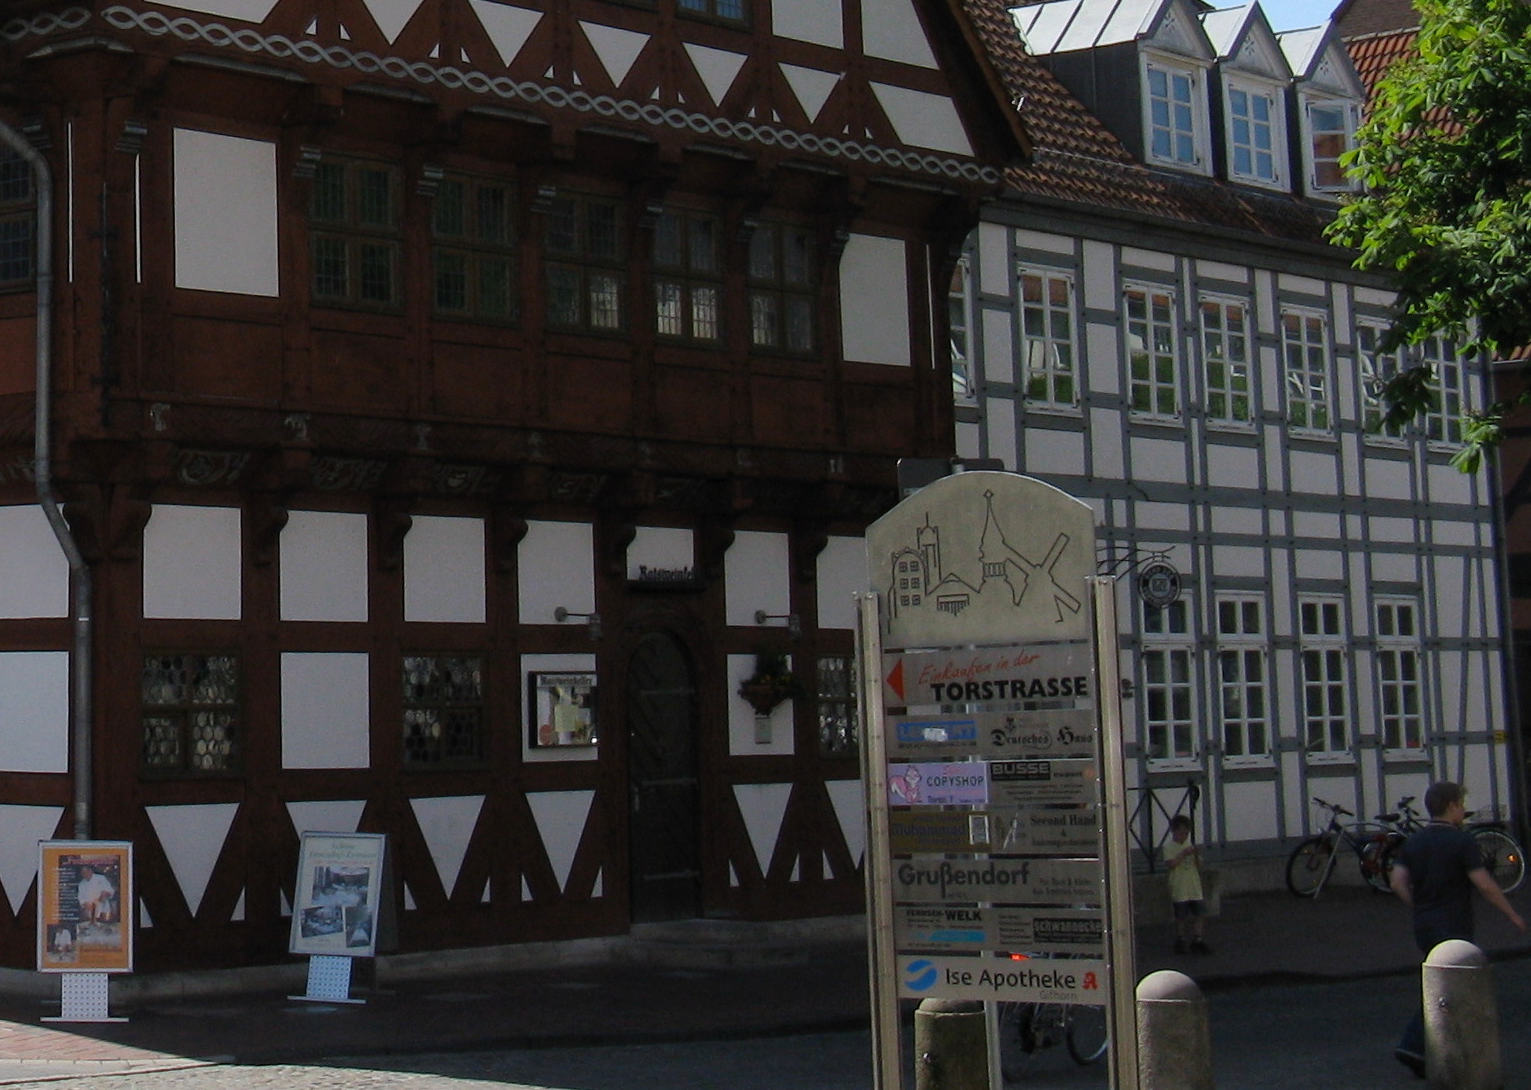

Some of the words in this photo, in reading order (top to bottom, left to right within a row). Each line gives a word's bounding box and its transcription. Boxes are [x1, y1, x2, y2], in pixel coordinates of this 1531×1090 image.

[1013, 649, 1040, 667] der
[930, 676, 1087, 701] TORSTRASSE
[1056, 726, 1093, 745] Haus
[992, 762, 1049, 775] BUSSE
[926, 775, 984, 787] COPYSHOP
[1030, 814, 1064, 826] Second
[1068, 812, 1096, 825] Hand
[898, 861, 1029, 898] Grußendorf
[946, 968, 972, 986] Ise
[979, 969, 1077, 992] Apotheke
